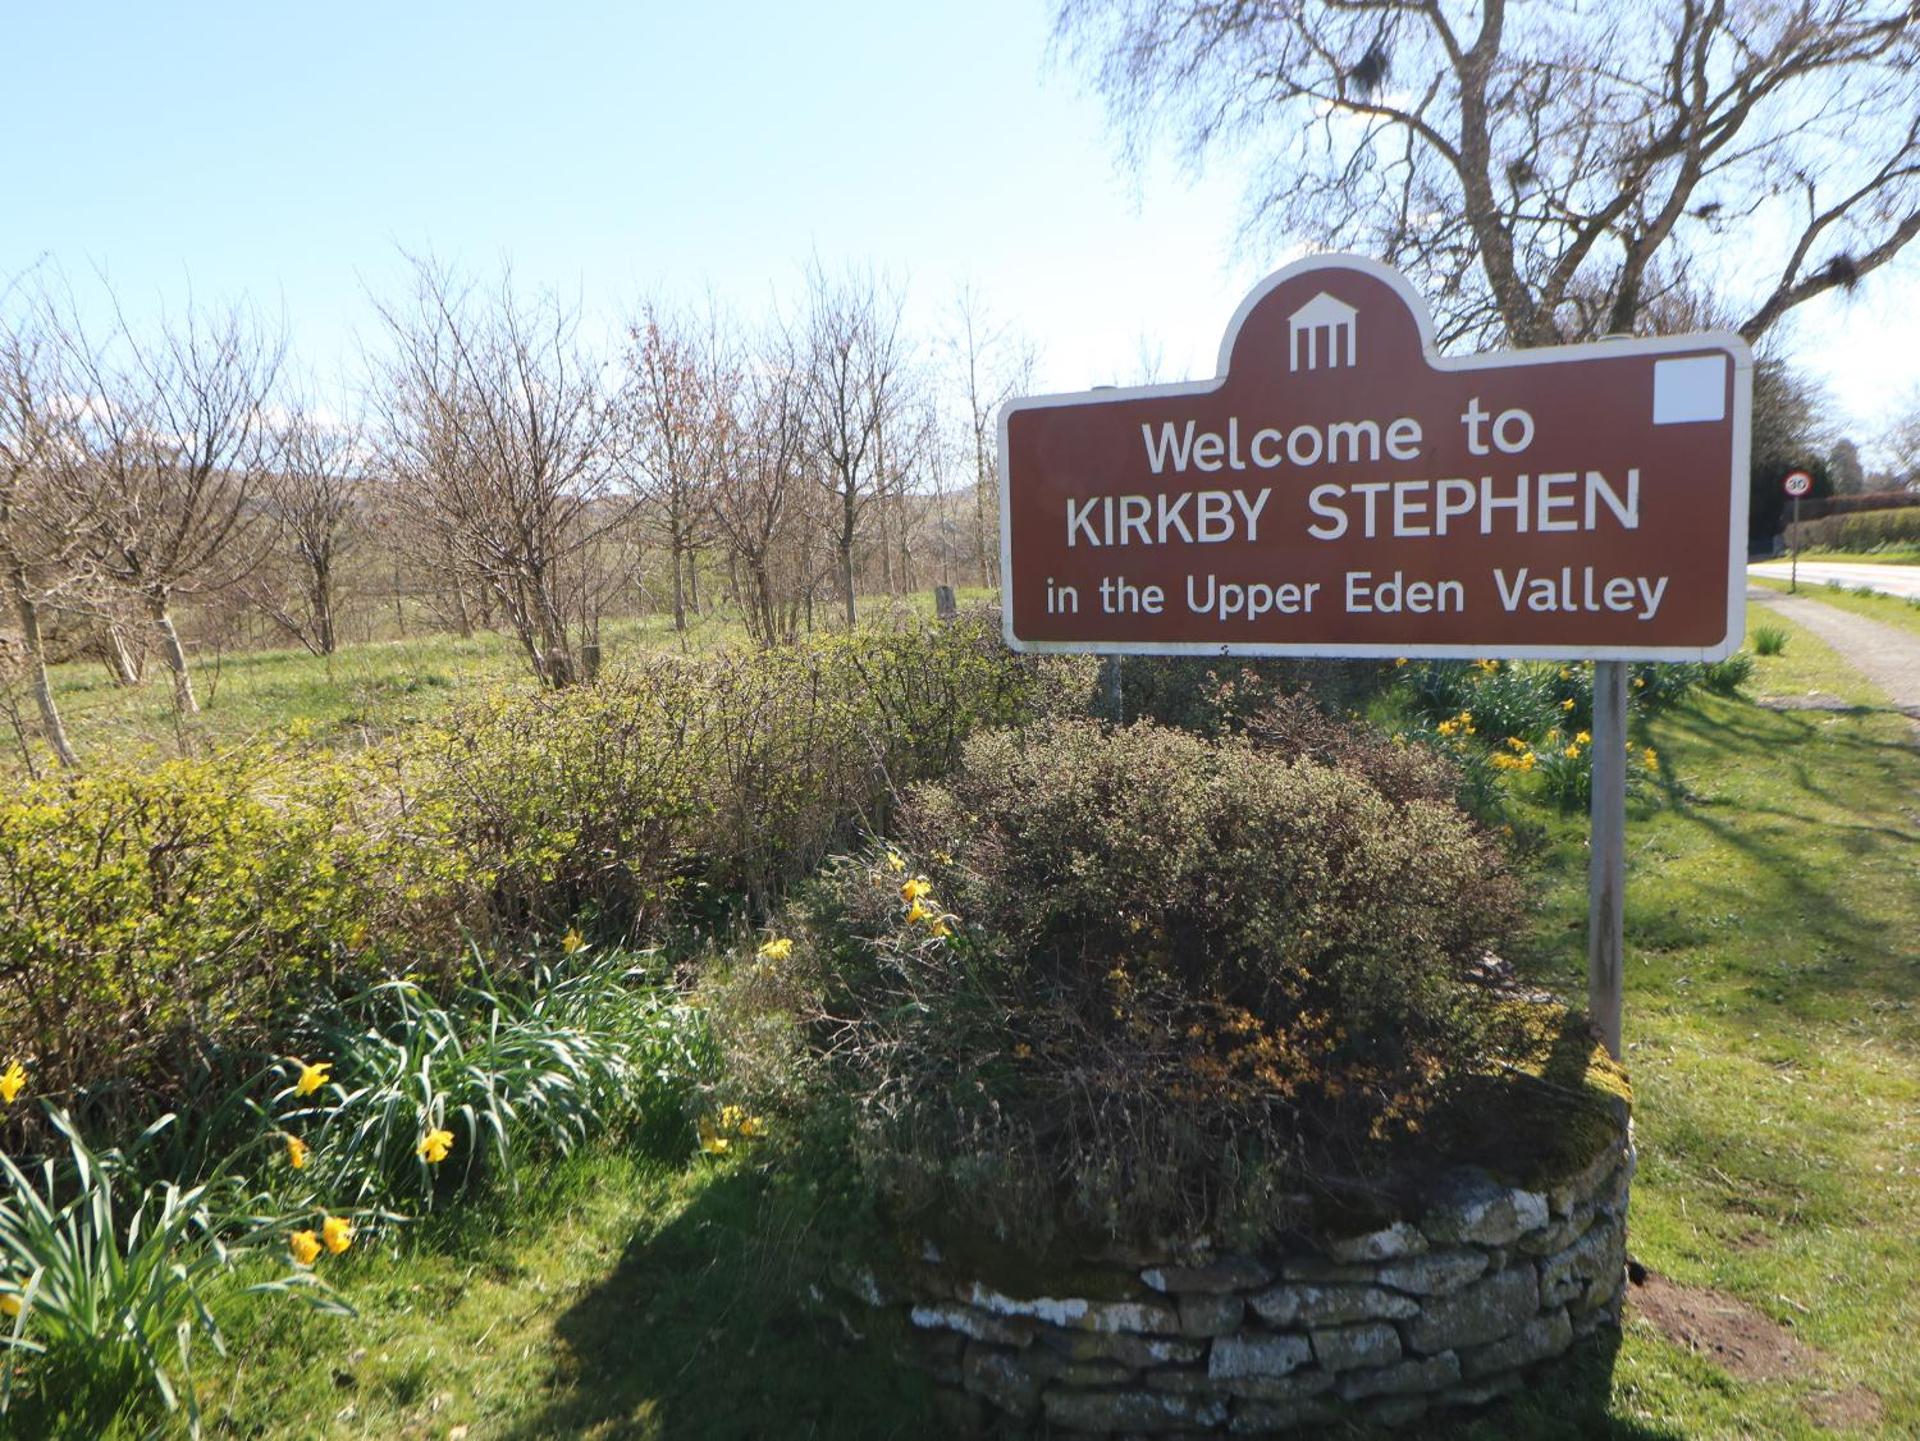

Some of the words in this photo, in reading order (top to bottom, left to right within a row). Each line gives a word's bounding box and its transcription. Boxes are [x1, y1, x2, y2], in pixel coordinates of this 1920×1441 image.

[1141, 418, 1422, 473] Welcome
[1461, 397, 1535, 455] to
[1066, 488, 1272, 547] KIRKBY
[1307, 469, 1640, 541] STEPHEN
[1047, 578, 1078, 613] in
[1099, 577, 1164, 613] the
[1187, 574, 1320, 620] Upper
[1345, 571, 1464, 613] Eden
[1493, 567, 1668, 619] Valley
